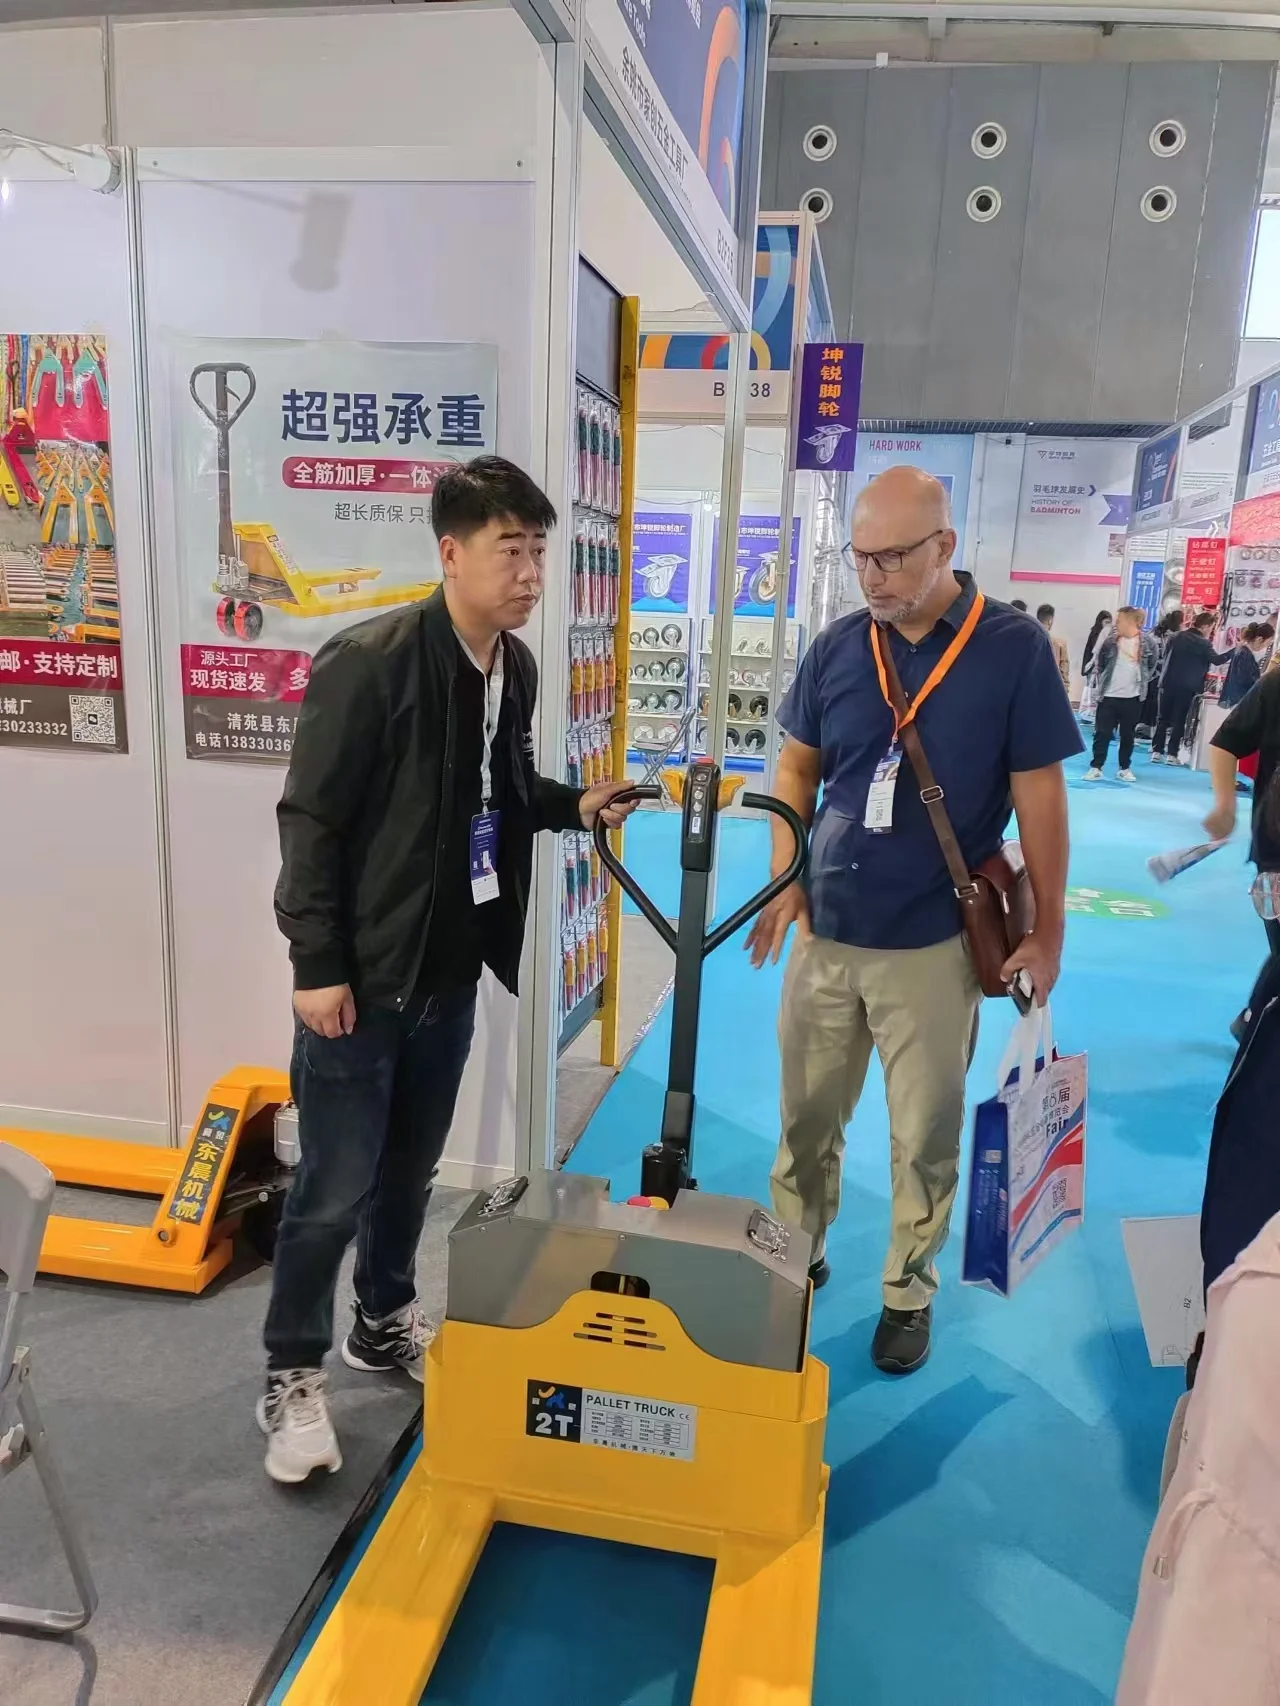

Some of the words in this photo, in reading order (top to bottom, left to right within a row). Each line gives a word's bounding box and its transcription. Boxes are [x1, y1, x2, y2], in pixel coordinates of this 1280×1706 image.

[817, 347, 844, 417] 坤锐脚轮
[281, 388, 485, 447] 超强承重
[869, 440, 893, 451] HARD
[896, 440, 922, 452] WORK
[334, 501, 404, 523] 超长质保
[1030, 506, 1081, 515] BADMINTON
[200, 650, 258, 668] 源头工厂
[190, 669, 267, 693] 现货速发
[289, 667, 309, 691] 多
[0, 697, 32, 715] 械厂
[227, 712, 299, 734] 清苑县东
[195, 731, 295, 752] 电话13833036
[1046, 1117, 1069, 1138] Fair
[175, 1142, 217, 1220] 东晨机械
[586, 1394, 631, 1412] PALLET
[633, 1402, 676, 1418] TRUCK
[535, 1412, 574, 1437] 2T
